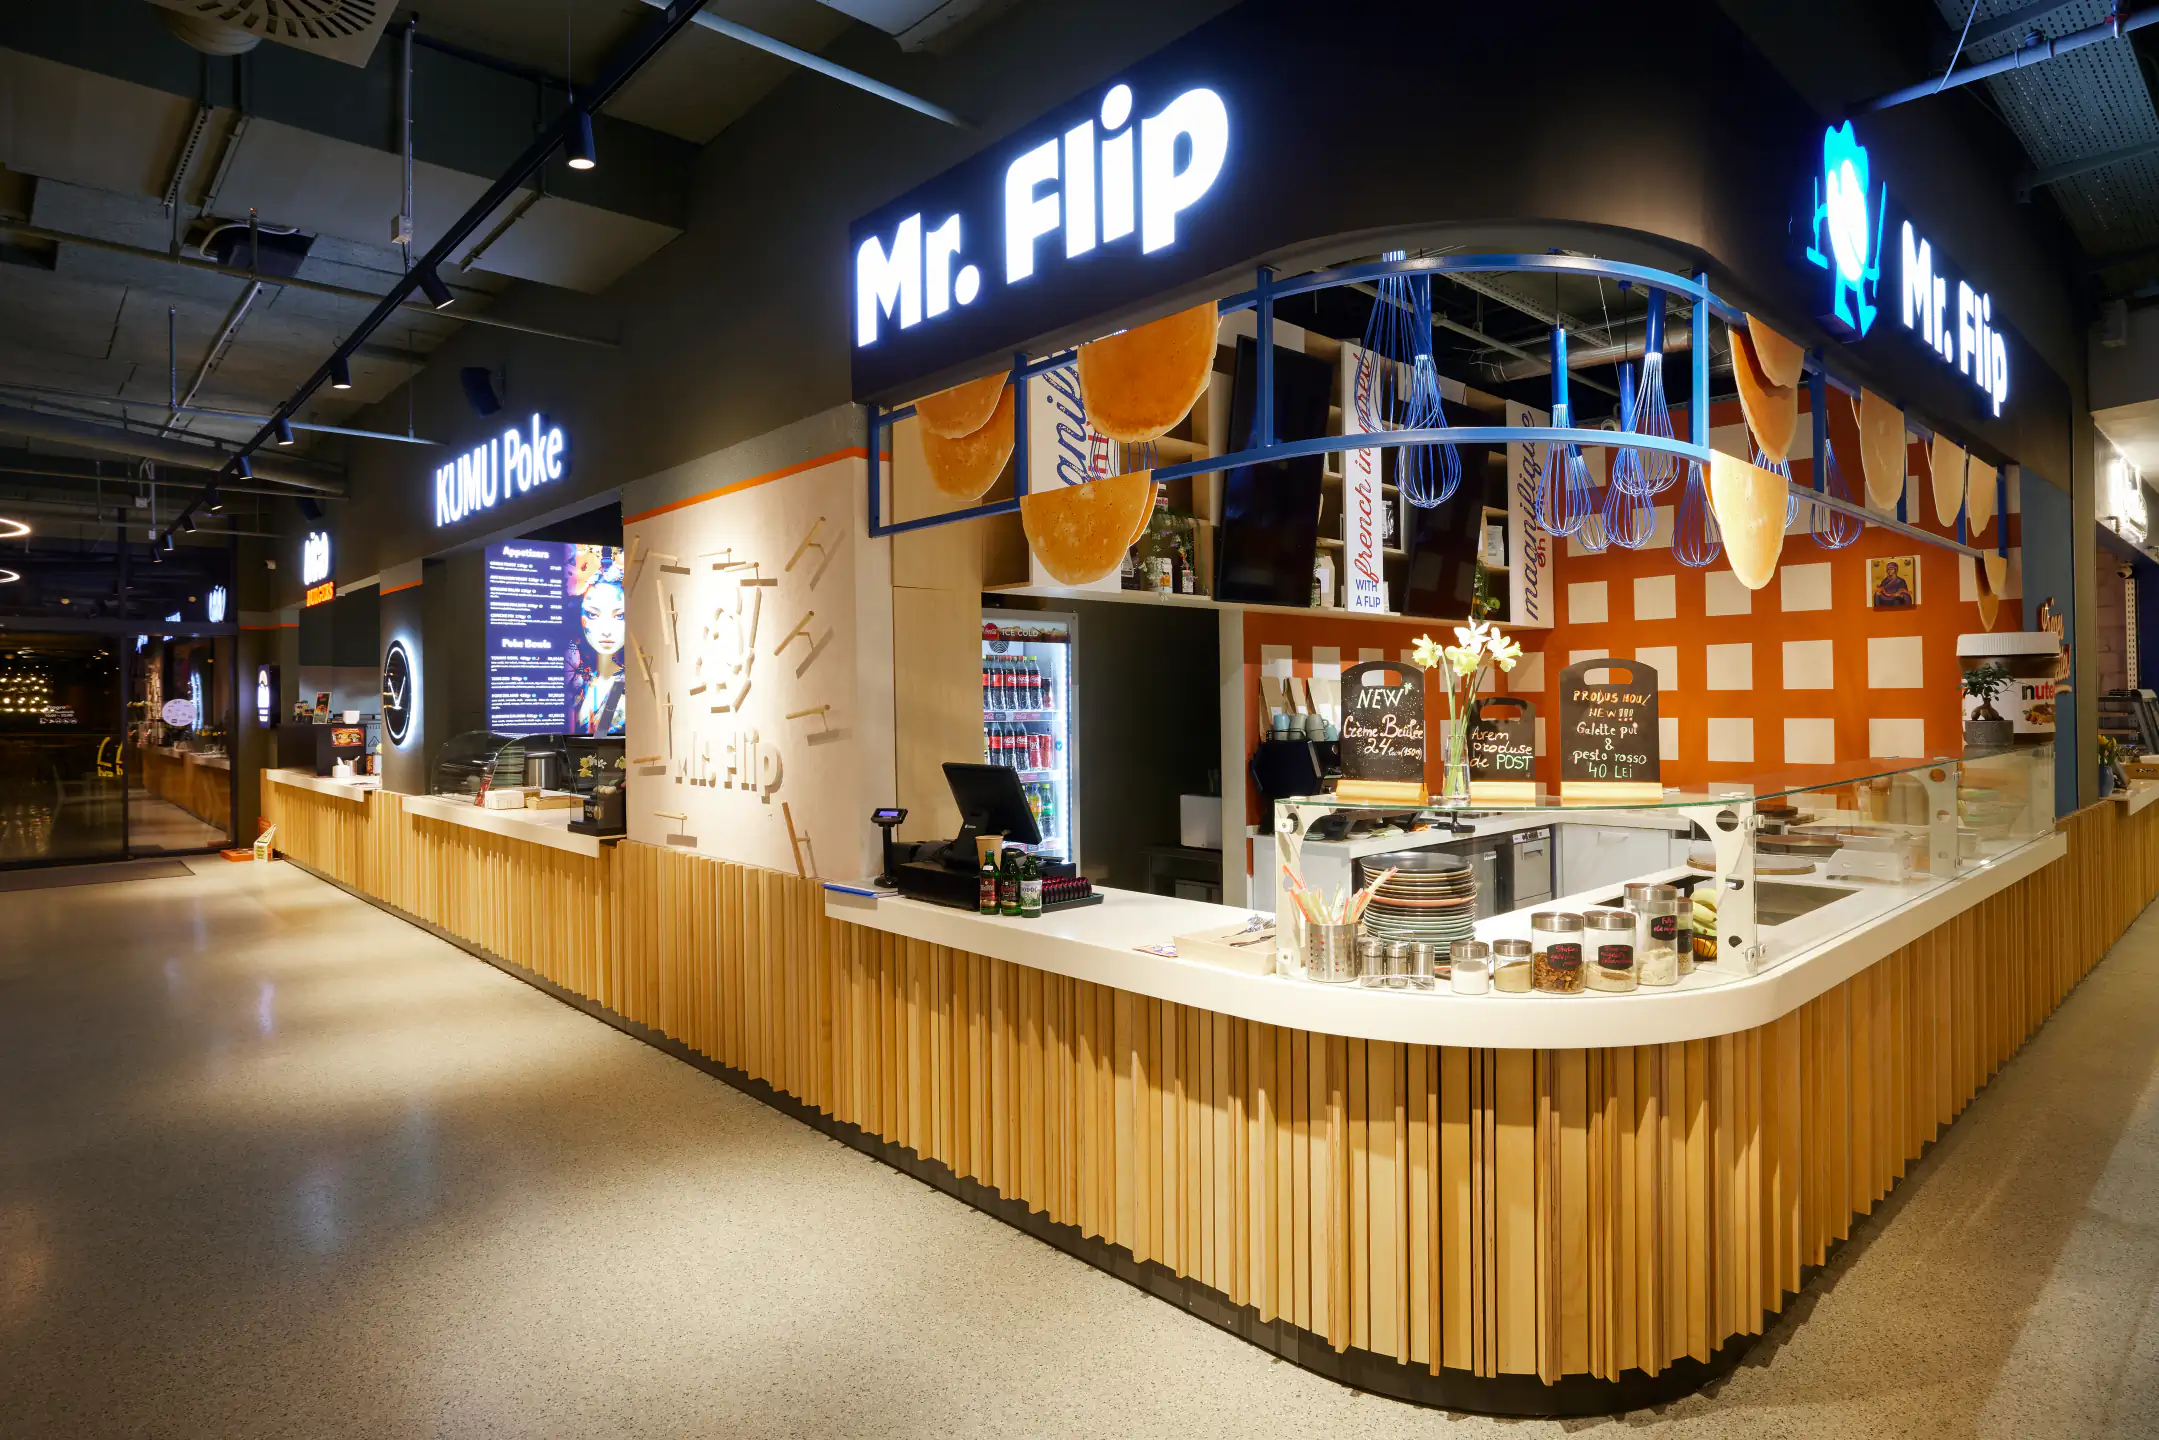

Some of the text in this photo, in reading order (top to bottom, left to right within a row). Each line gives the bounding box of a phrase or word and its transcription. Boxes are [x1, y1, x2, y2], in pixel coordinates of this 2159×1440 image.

[857, 84, 1229, 347] Mr. Flip
[1902, 220, 2008, 418] Mr. Flip
[436, 412, 563, 527] KUMU Poke
[1354, 478, 1379, 583] french
[502, 545, 550, 558] Appetizers
[1355, 578, 1378, 592] WITH
[1356, 595, 1381, 608] A FLIP
[1017, 629, 1039, 637] COLD
[501, 638, 551, 649] Poke Bowls
[1356, 688, 1405, 709] NEW
[1573, 690, 1618, 704] PRODUS
[1343, 715, 1379, 738] Crème
[1576, 721, 1639, 738] Galette pui
[1364, 738, 1392, 755] 24
[1604, 737, 1614, 751] &
[673, 726, 784, 804] Mr. Flip
[1470, 754, 1534, 770] de POST
[1572, 748, 1647, 765] pesto rosso
[1588, 762, 1607, 778] 40
